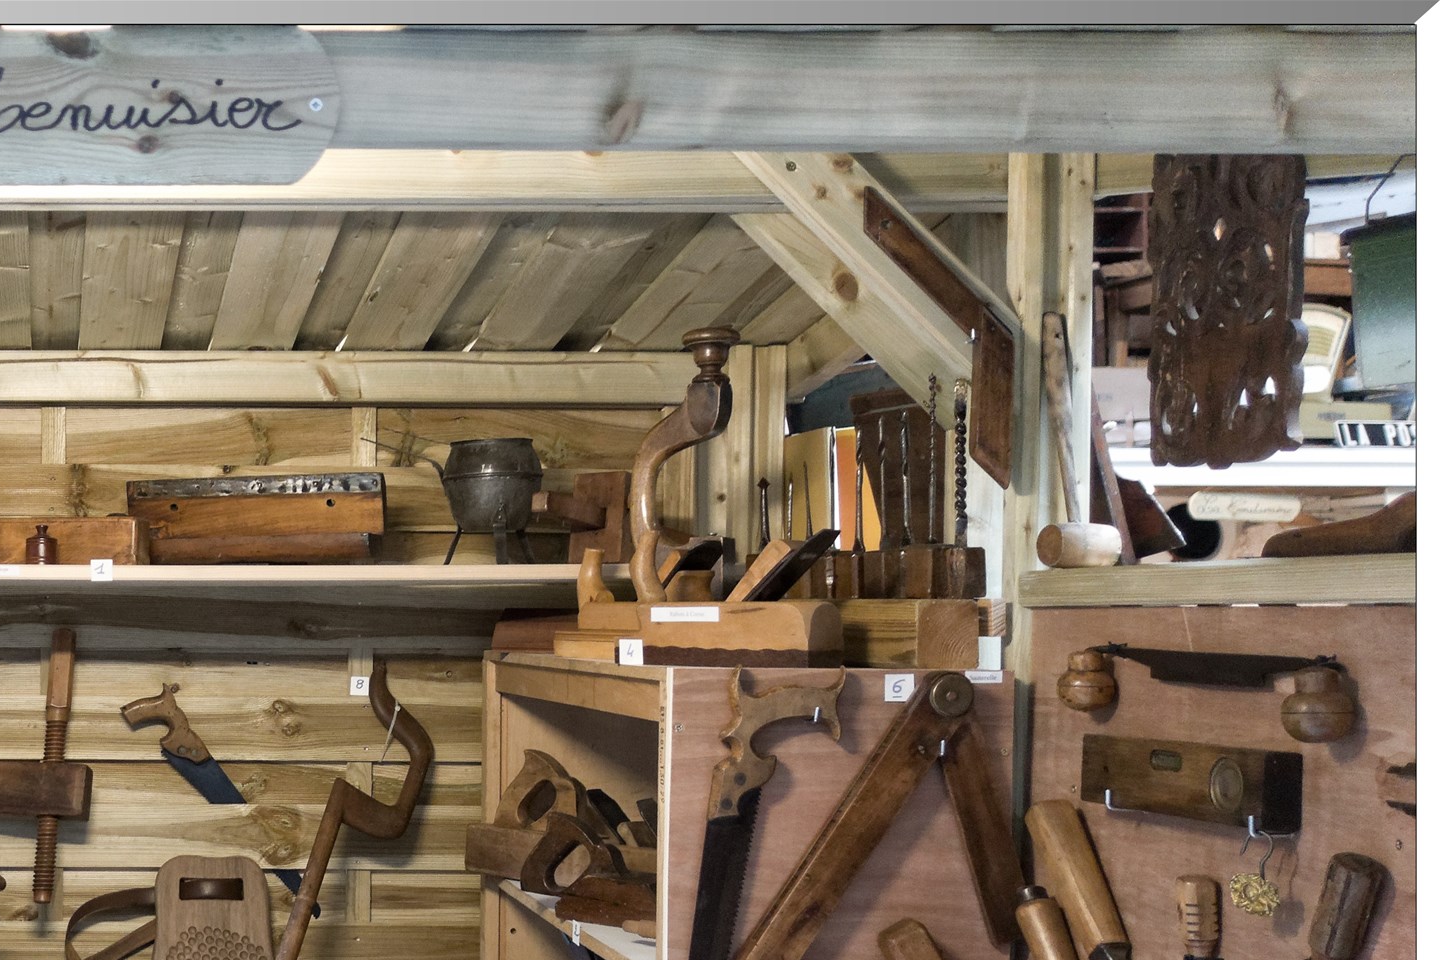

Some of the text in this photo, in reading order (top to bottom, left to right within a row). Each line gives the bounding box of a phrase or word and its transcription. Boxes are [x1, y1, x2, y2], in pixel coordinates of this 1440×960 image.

[1342, 423, 1371, 447] LA
[94, 562, 105, 575] 1
[626, 643, 634, 657] 4
[355, 679, 365, 690] 8
[892, 679, 906, 694] 6
